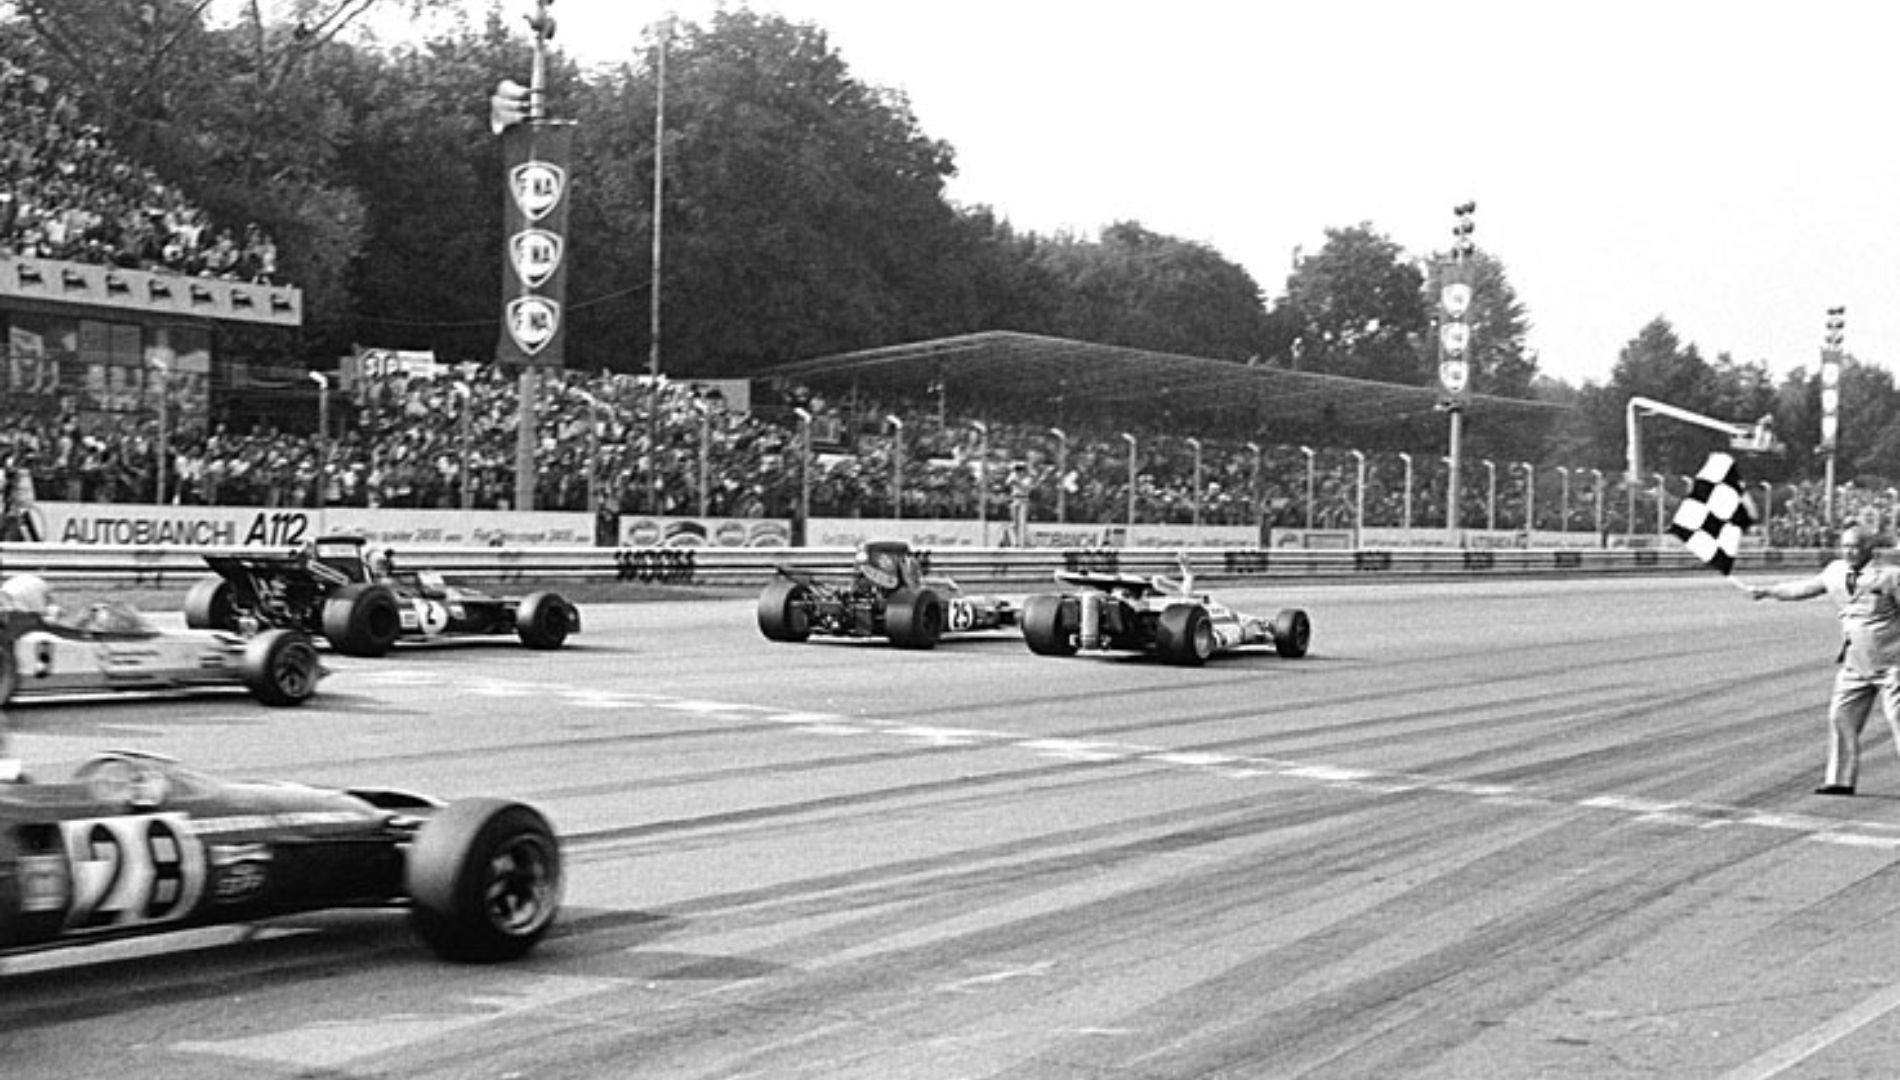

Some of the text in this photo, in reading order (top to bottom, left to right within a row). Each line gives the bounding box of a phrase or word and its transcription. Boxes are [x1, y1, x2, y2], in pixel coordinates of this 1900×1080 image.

[517, 177, 553, 197] FNA
[516, 245, 551, 264] FNA
[514, 311, 548, 330] FNA
[62, 517, 236, 546] AUTOBIANCHI
[243, 512, 308, 546] A112
[426, 601, 437, 625] 2
[952, 601, 970, 628] 25
[63, 819, 183, 928] 28
